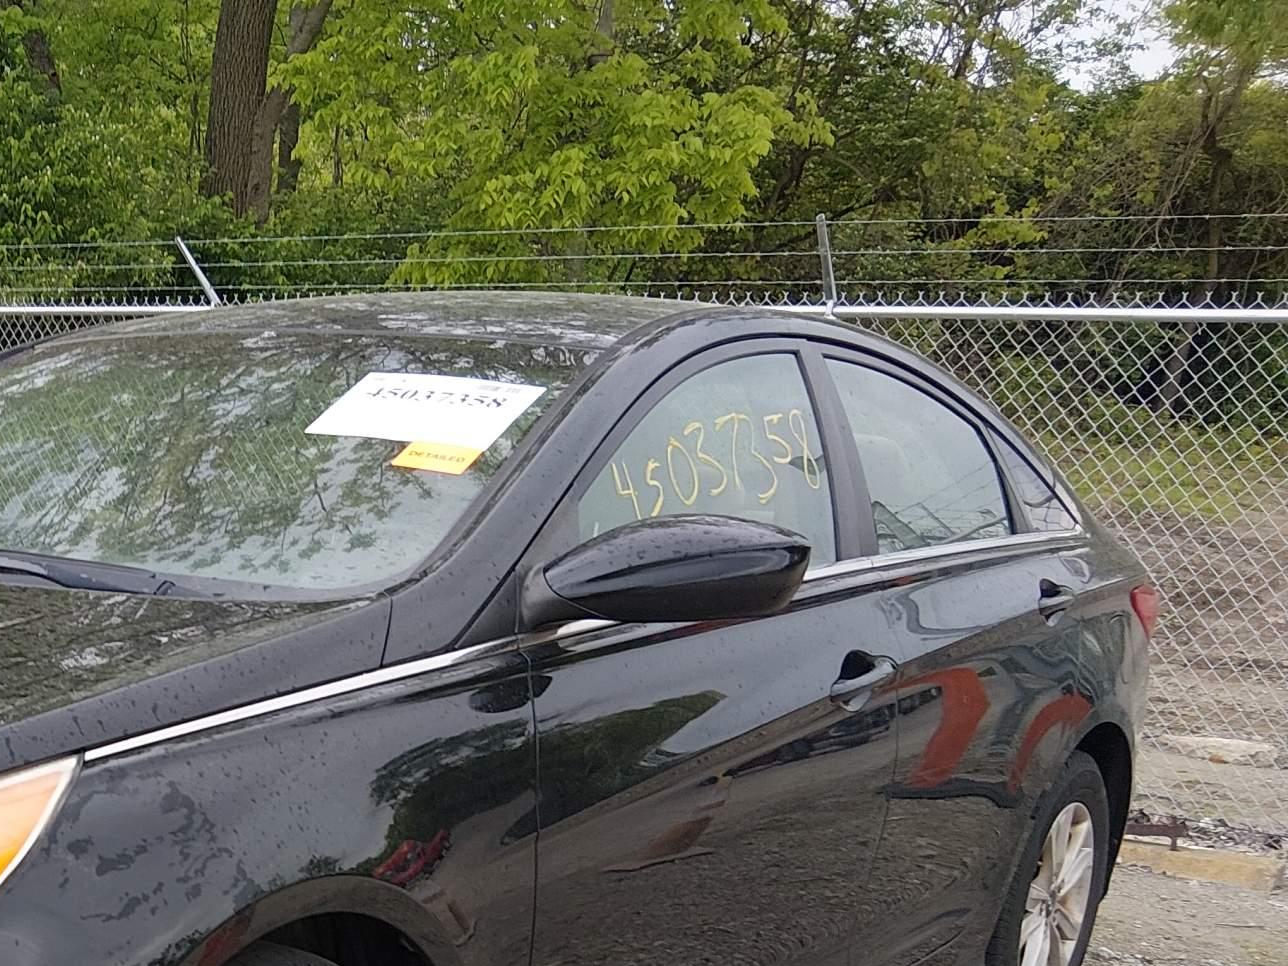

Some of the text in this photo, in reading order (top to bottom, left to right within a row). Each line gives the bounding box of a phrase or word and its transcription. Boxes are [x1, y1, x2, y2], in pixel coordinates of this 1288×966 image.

[366, 387, 508, 408] 45037358
[408, 450, 466, 463] DETAILED
[610, 408, 821, 520] 45037358
